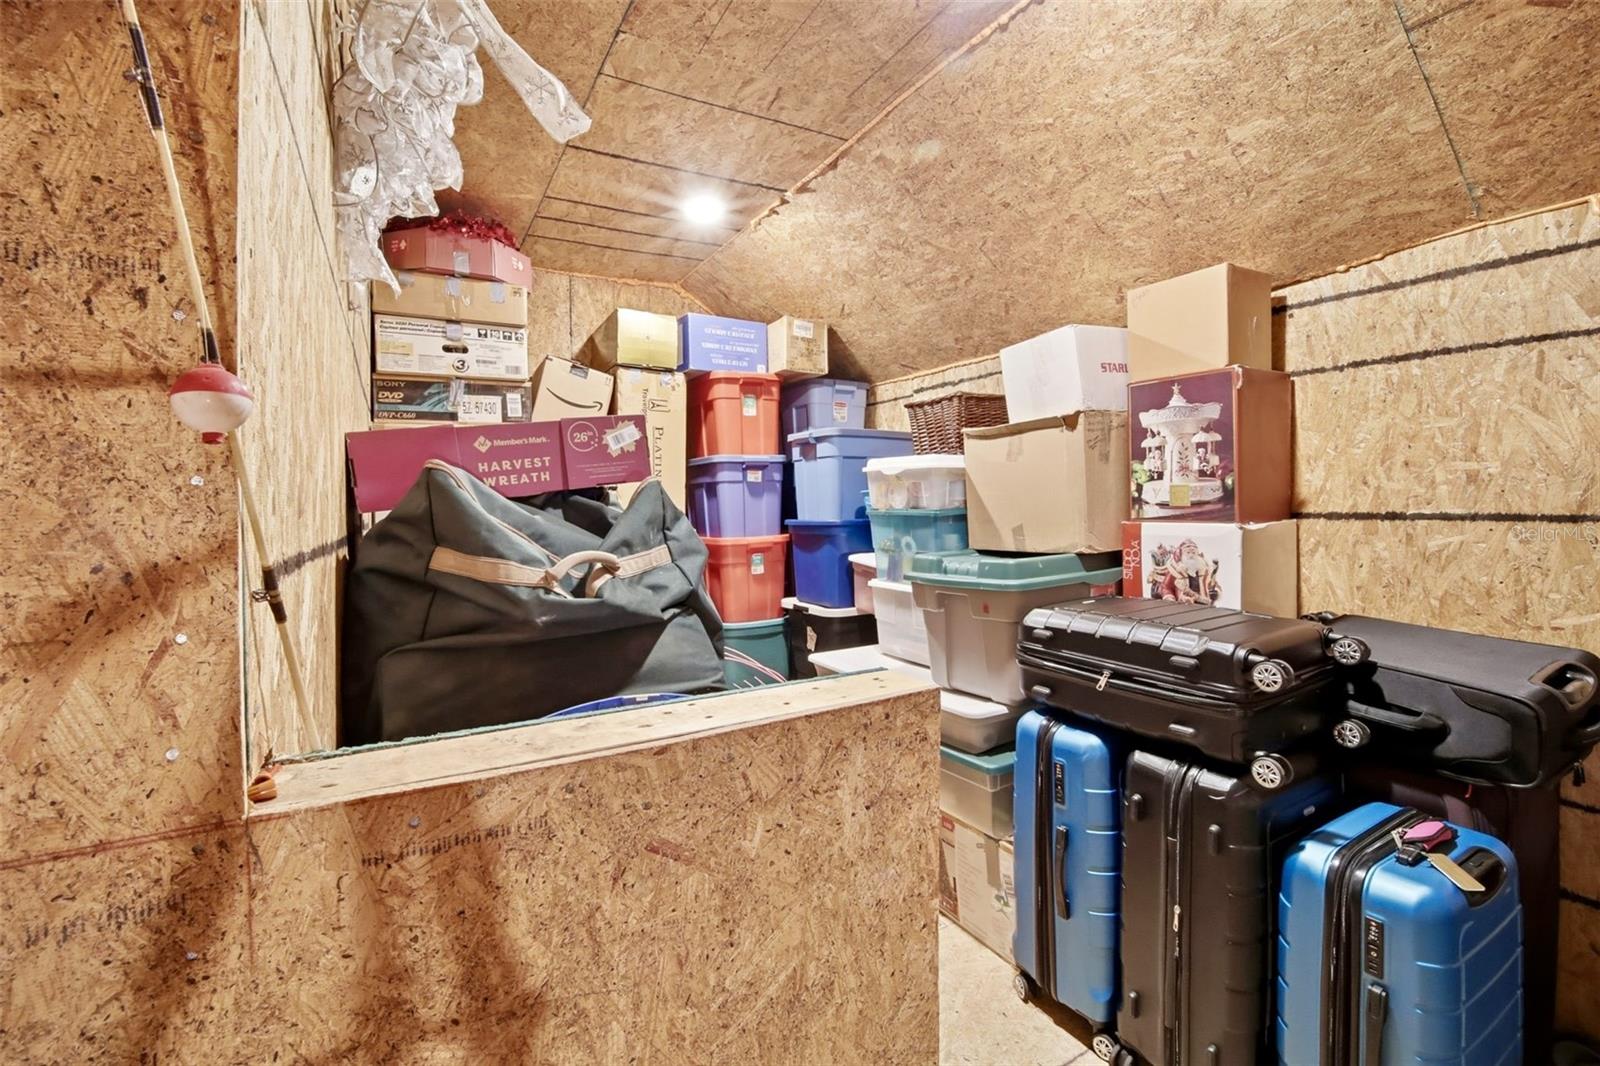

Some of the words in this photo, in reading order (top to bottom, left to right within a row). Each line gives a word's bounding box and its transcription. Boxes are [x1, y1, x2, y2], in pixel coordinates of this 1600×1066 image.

[455, 359, 466, 370] 3
[377, 380, 406, 388] SONY
[377, 391, 404, 399] DVD
[493, 438, 528, 447] Member's
[528, 436, 547, 444] Mark
[478, 456, 551, 473] HARVEST
[483, 471, 550, 487] WREATH
